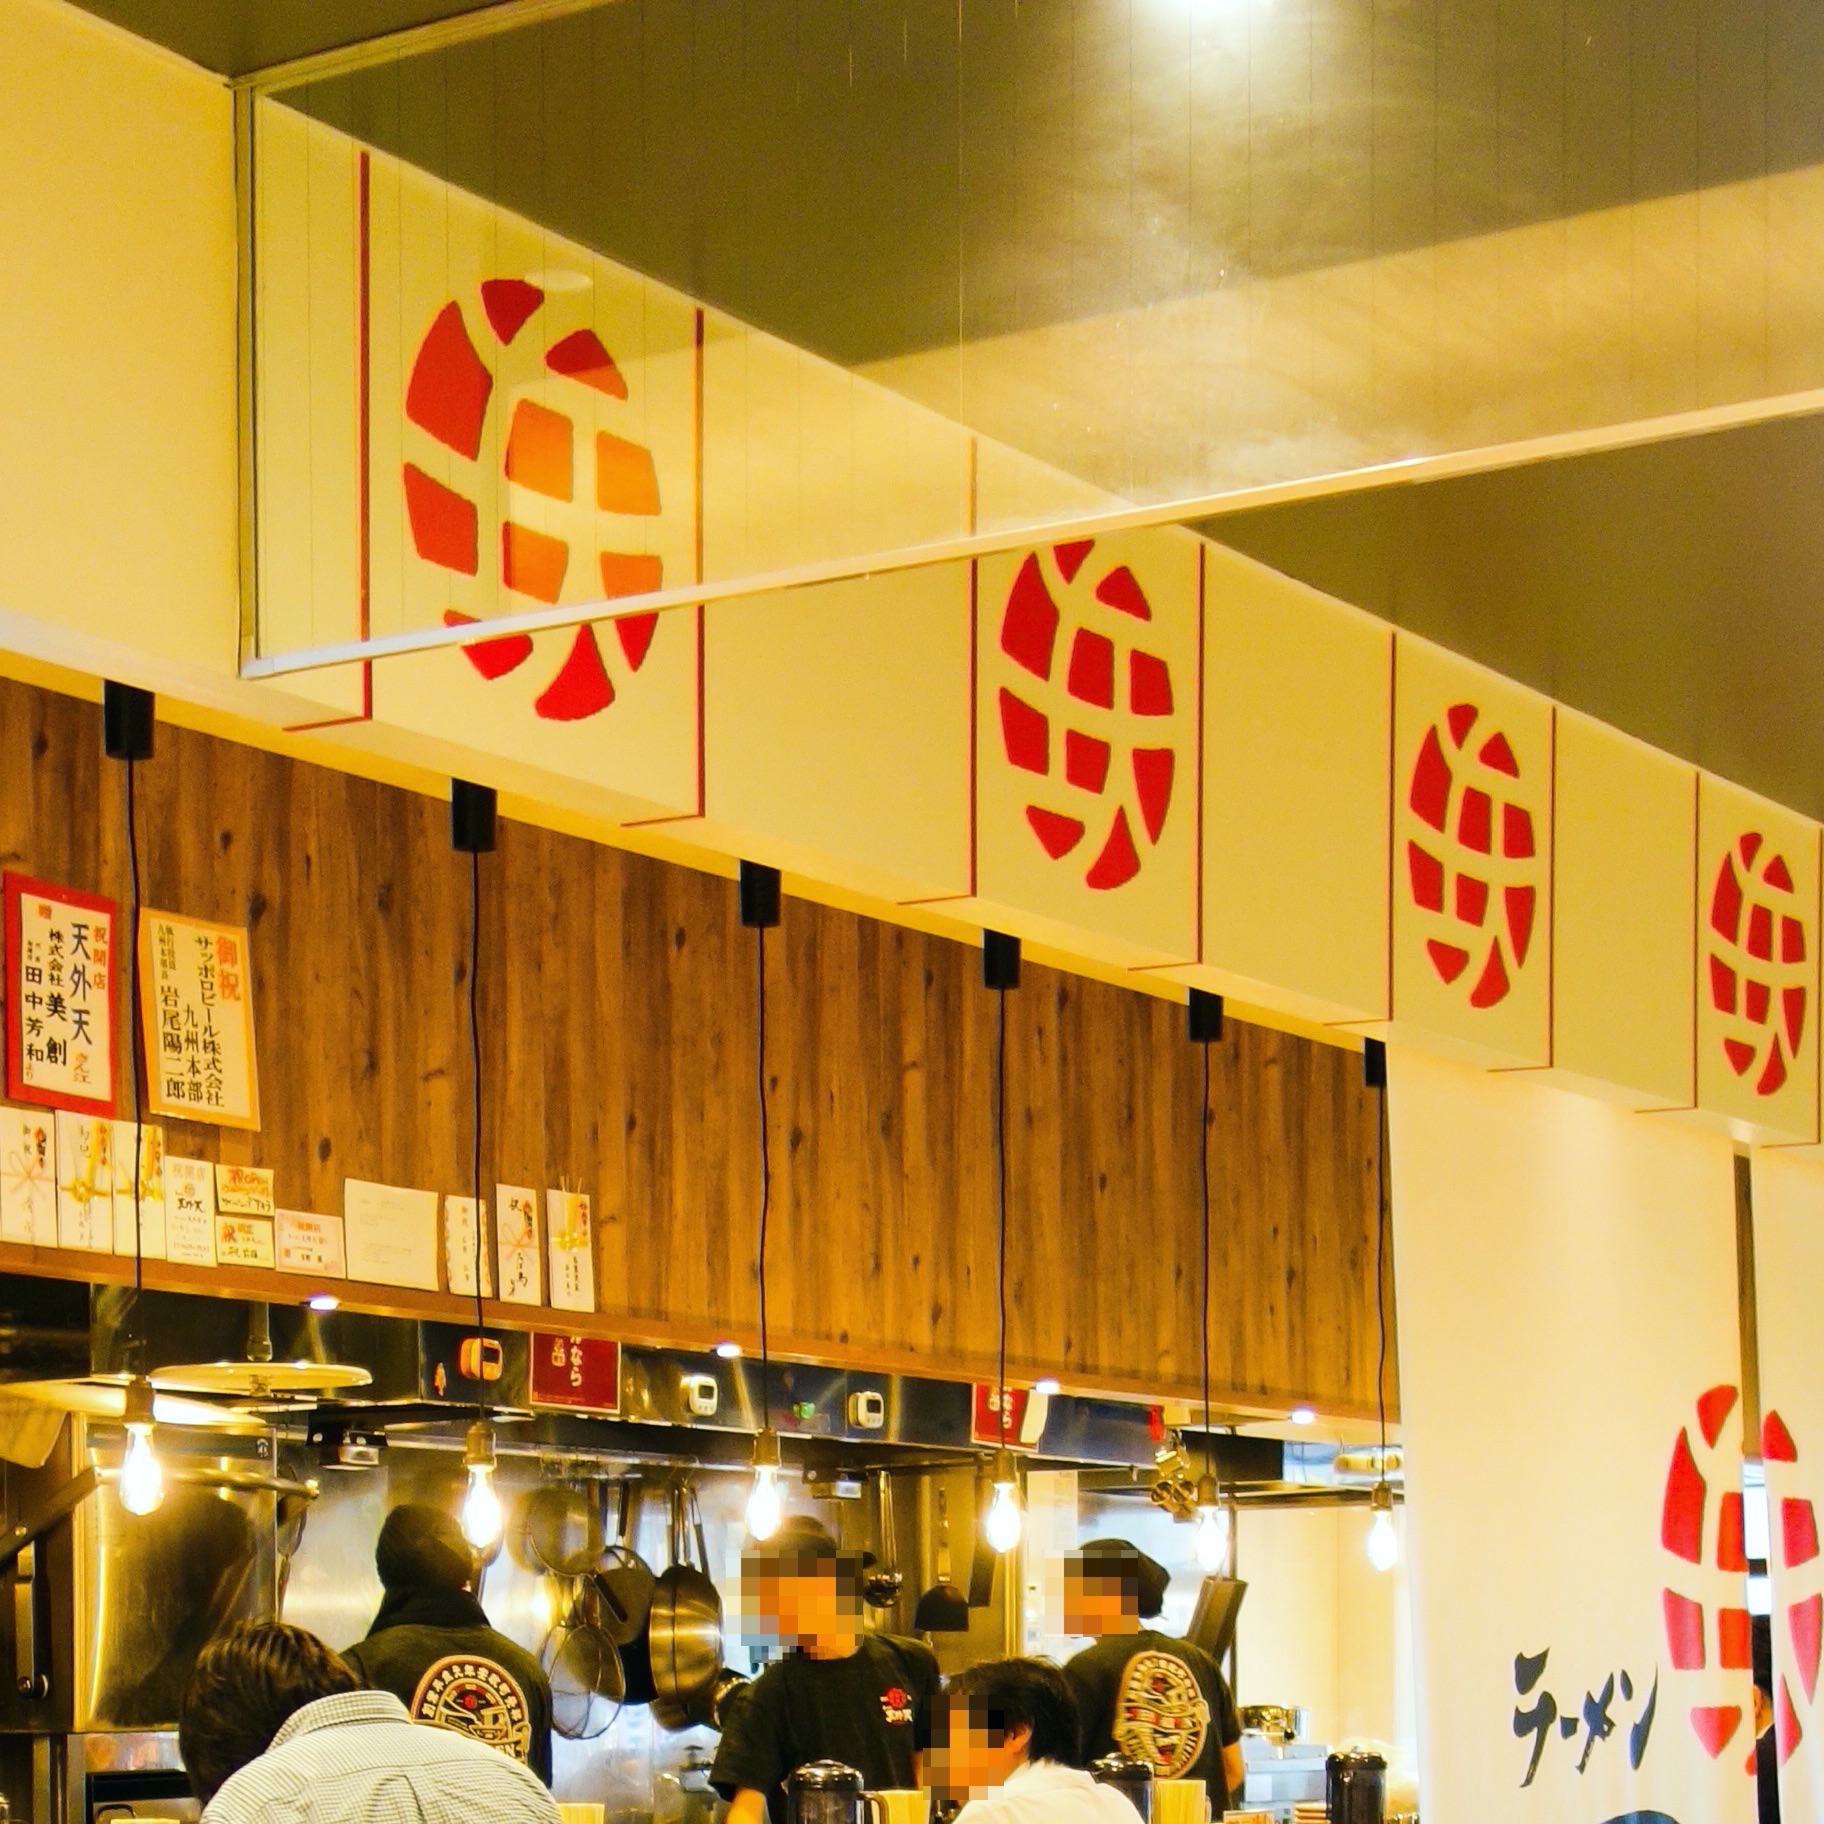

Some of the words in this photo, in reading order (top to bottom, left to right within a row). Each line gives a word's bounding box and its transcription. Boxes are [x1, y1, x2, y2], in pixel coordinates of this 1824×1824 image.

[47, 928, 65, 988] 株式会社
[69, 921, 93, 1046] 天外天
[215, 934, 242, 1003] 御祝
[160, 984, 187, 1101] 岩尾陽二郎
[183, 1002, 205, 1104] 九州本部
[194, 934, 226, 1109] サッポロビール株式会社
[1510, 1645, 1660, 1790] ラーメン
